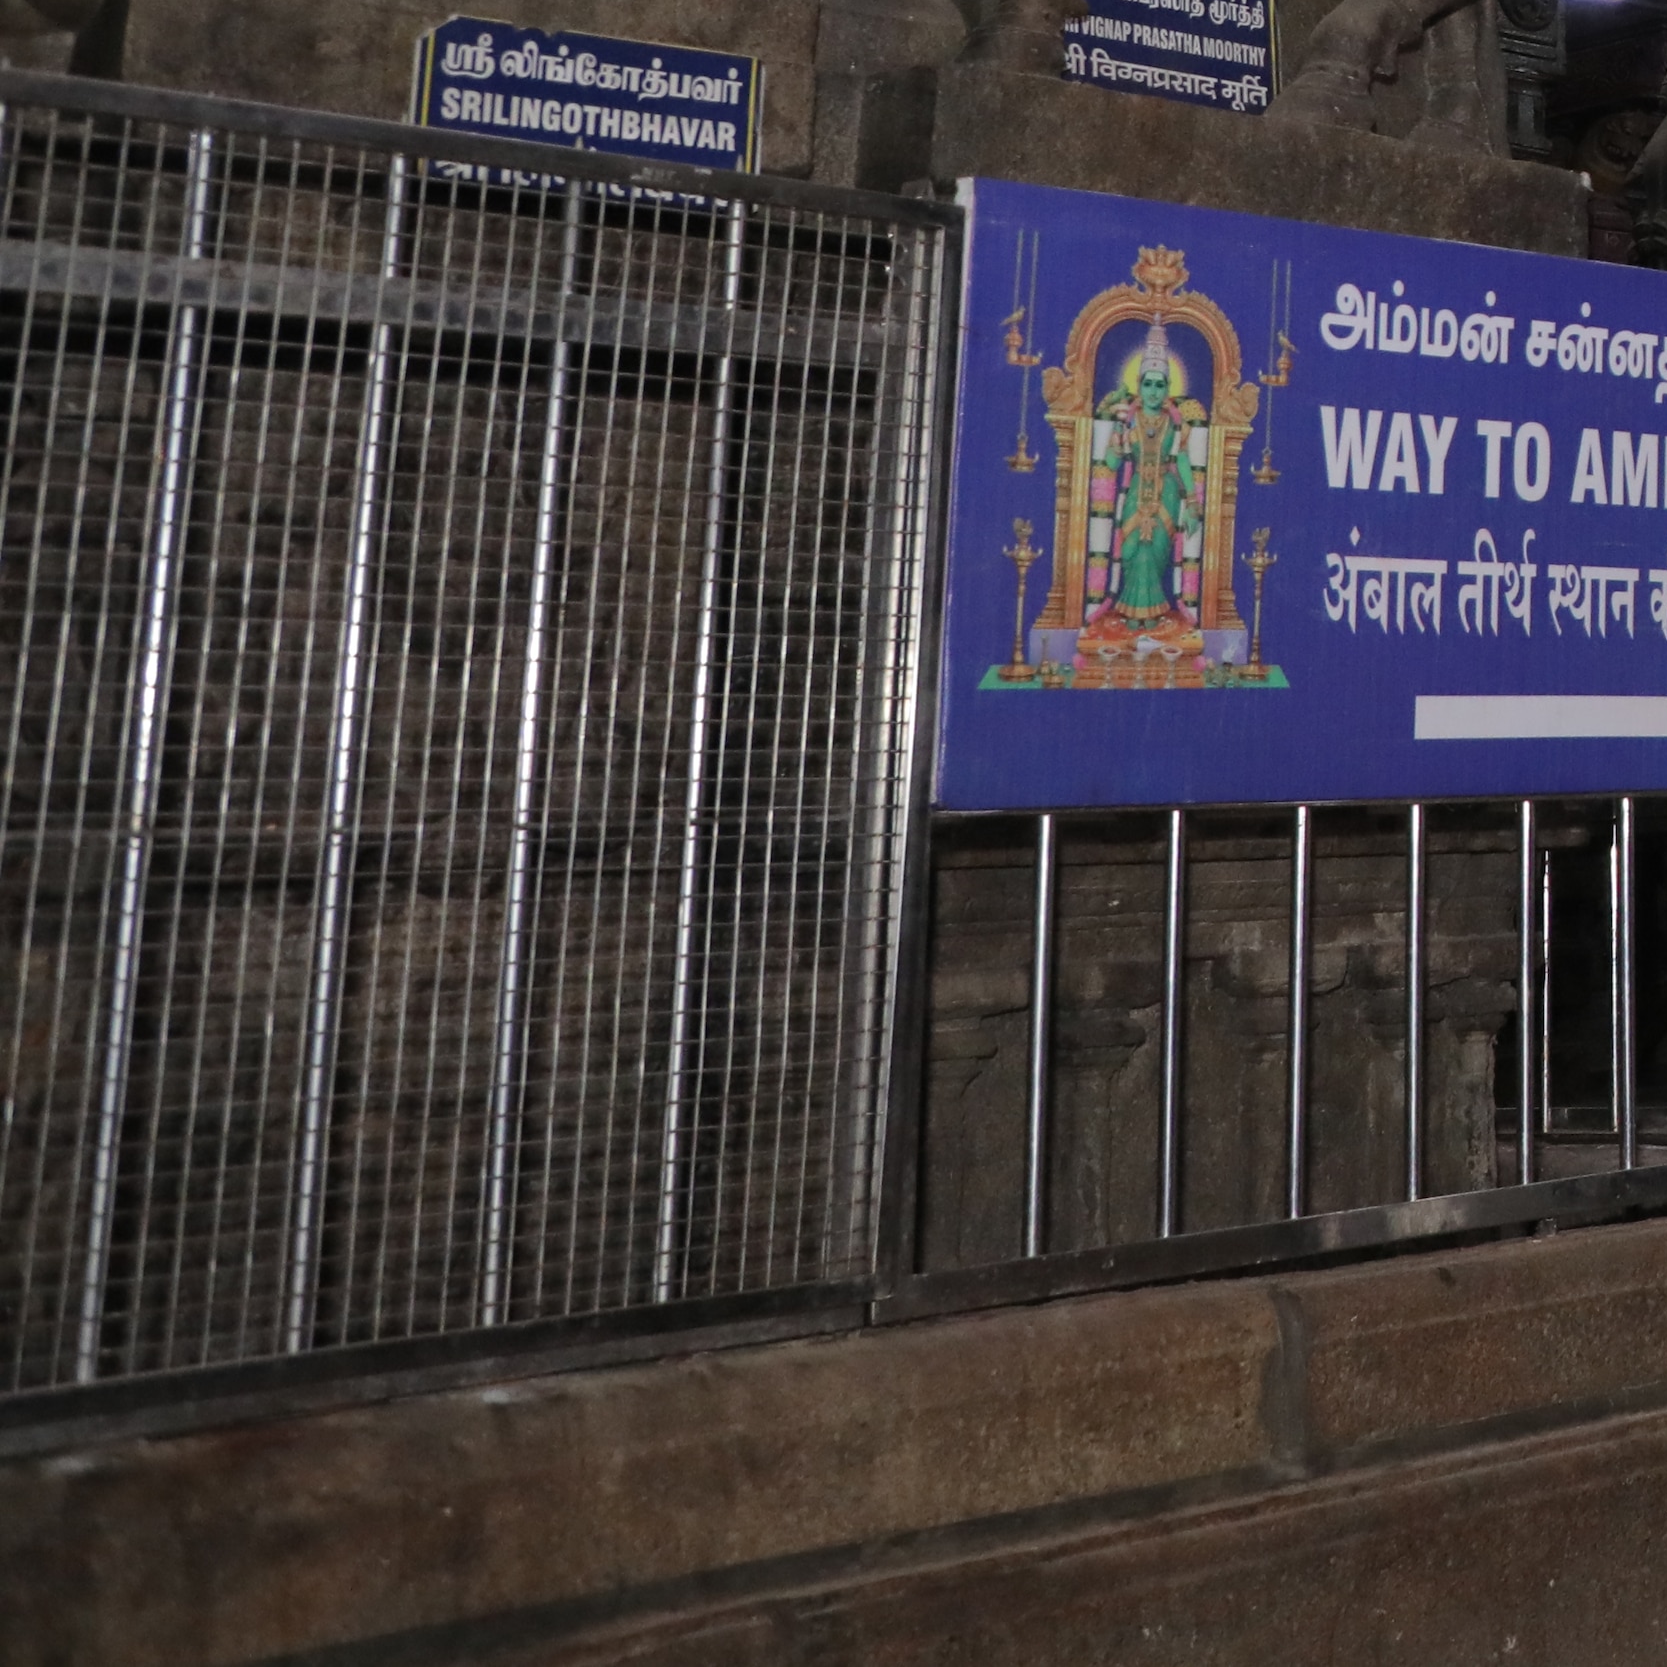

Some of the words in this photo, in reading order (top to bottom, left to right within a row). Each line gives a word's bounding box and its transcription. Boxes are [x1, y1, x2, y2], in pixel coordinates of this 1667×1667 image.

[500, 39, 743, 105] லிங்கோத்பவர்
[1081, 15, 1132, 43] VIGNAP
[1133, 24, 1202, 55] PRASATHA
[1203, 37, 1266, 68] MOORTHY
[441, 87, 737, 152] SRILINGOTHBHAVAR
[1321, 279, 1514, 365] அம்மன்
[1321, 405, 1457, 496] WAY
[1476, 418, 1552, 502] TO
[1323, 526, 1448, 635] अंबाल
[1457, 528, 1537, 637] तीर्थ
[1547, 562, 1639, 640] स्थान
